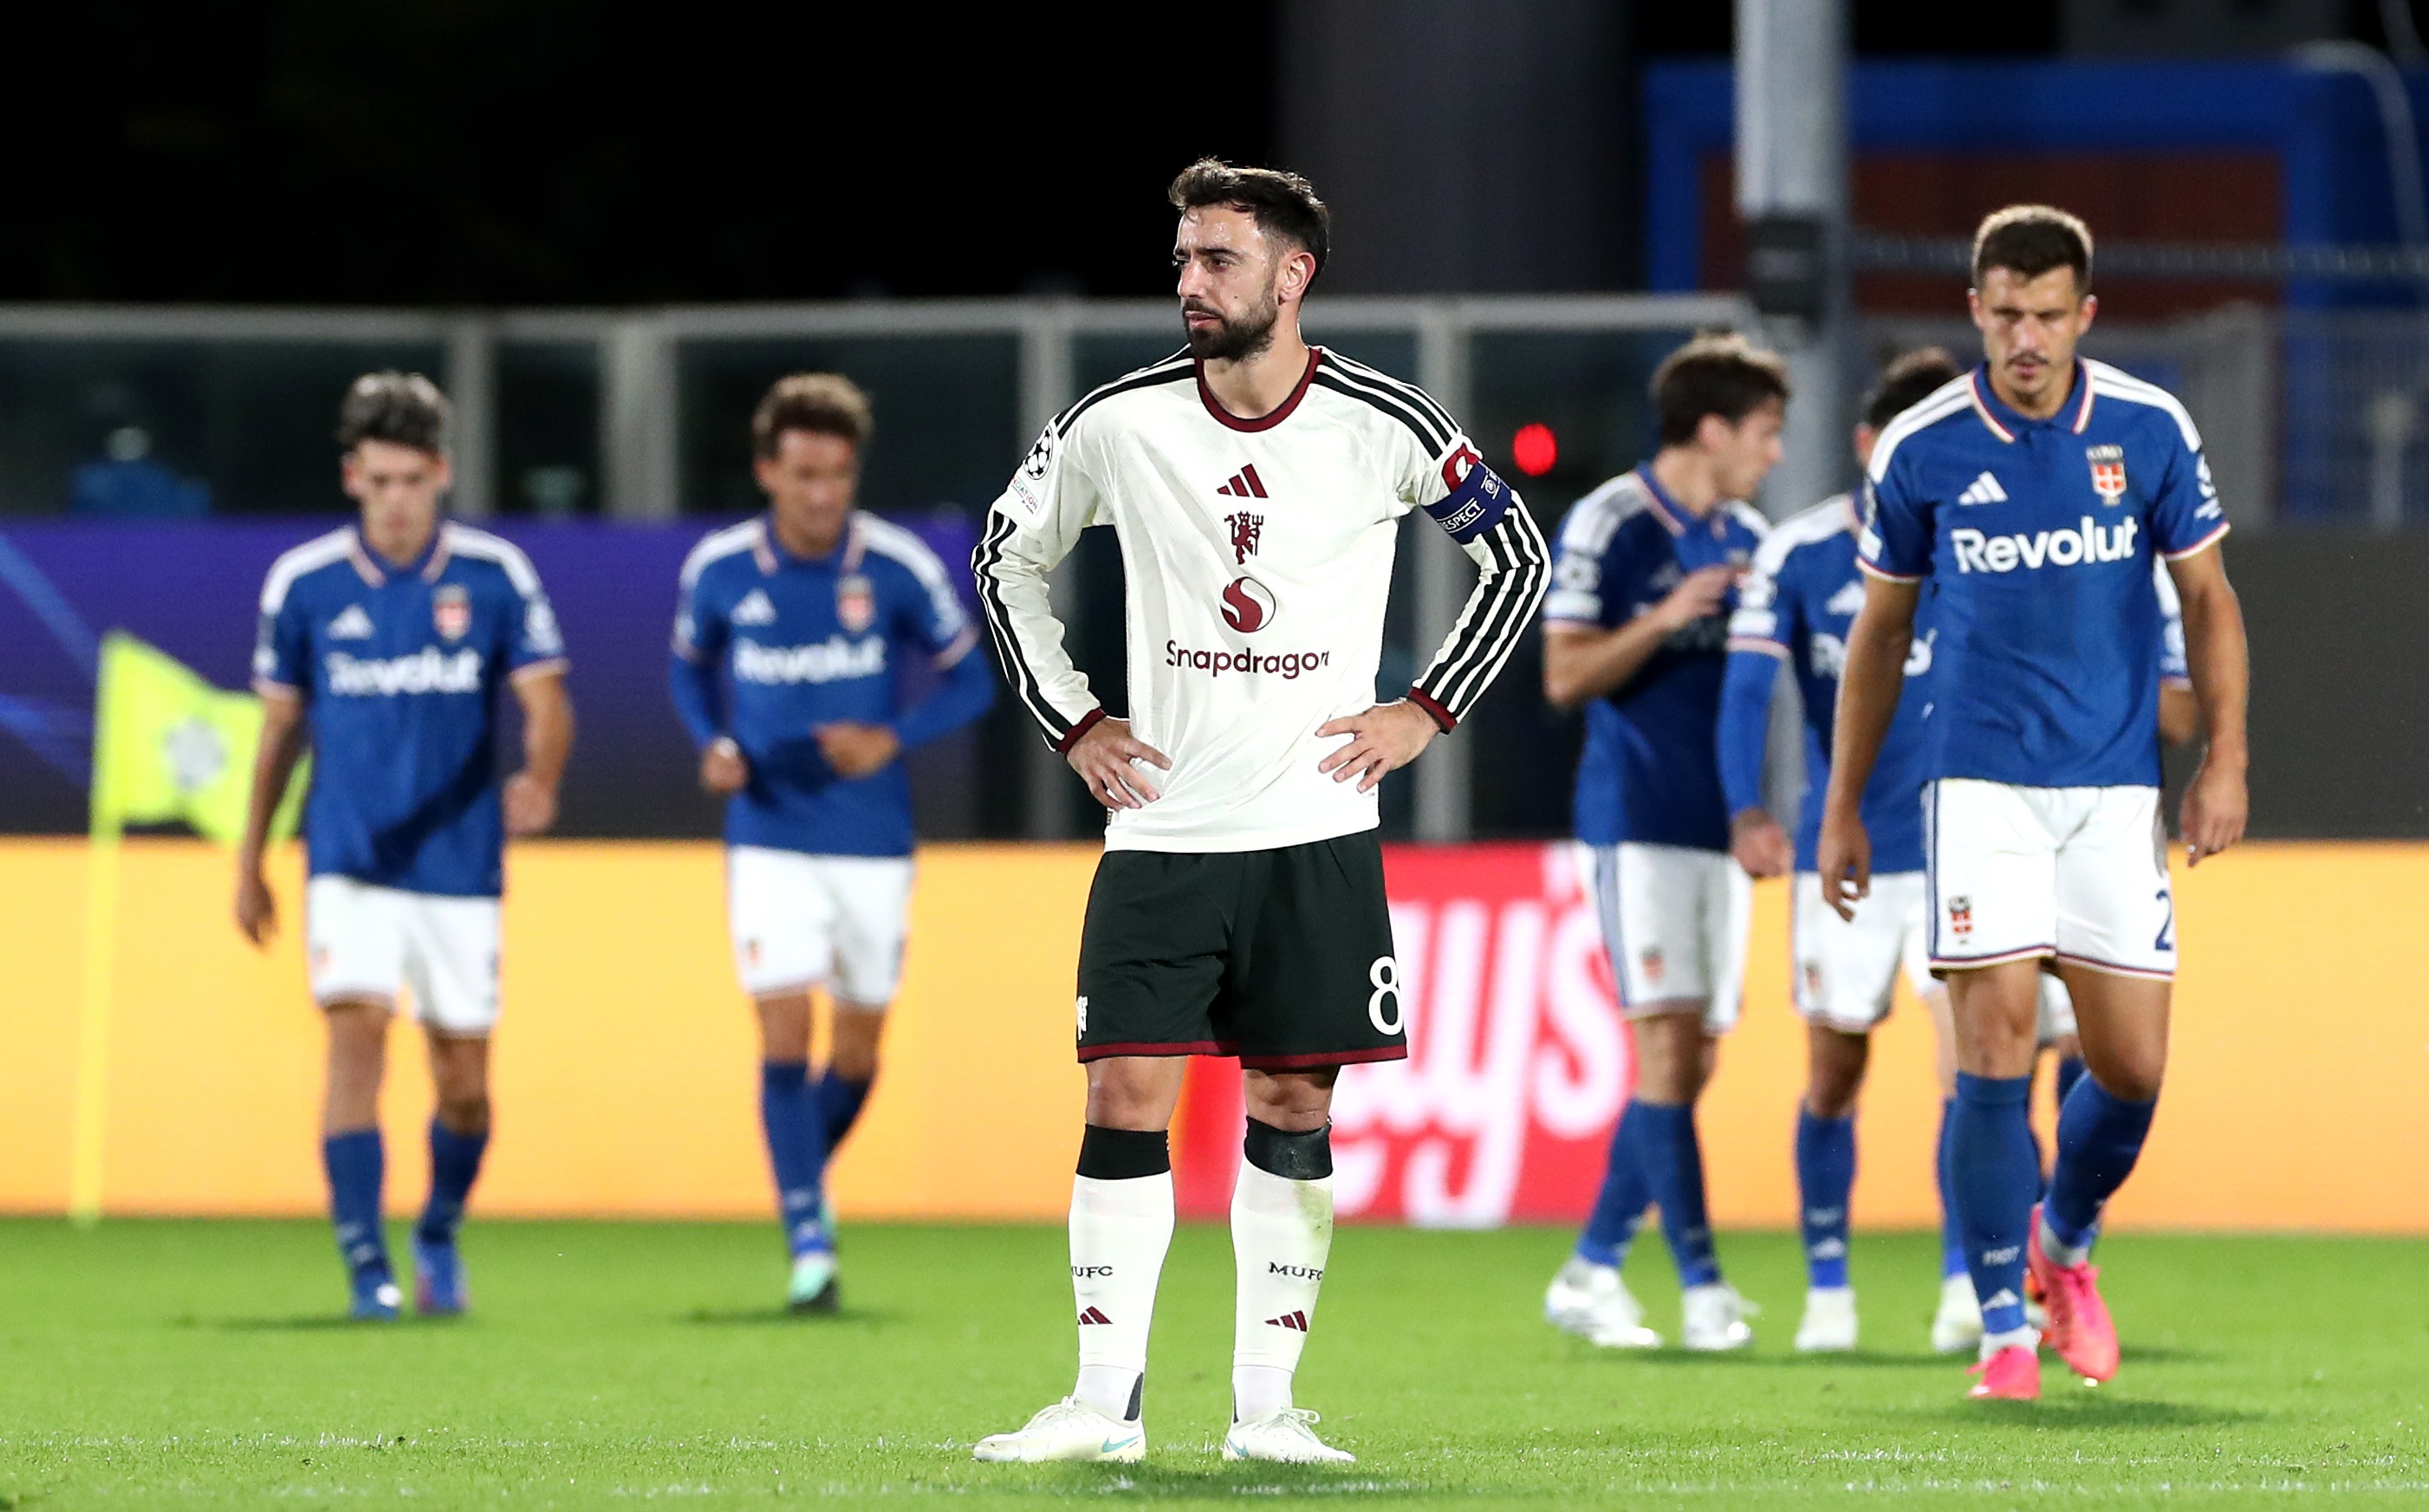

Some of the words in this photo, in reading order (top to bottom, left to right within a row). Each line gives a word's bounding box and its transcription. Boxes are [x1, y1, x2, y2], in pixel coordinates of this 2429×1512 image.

[1012, 477, 1038, 509] NDATION
[1951, 516, 2139, 574] Revolut
[1166, 639, 1329, 679] Snapdragon
[1368, 956, 1404, 1035] 8
[1268, 1262, 1323, 1281] MUFC
